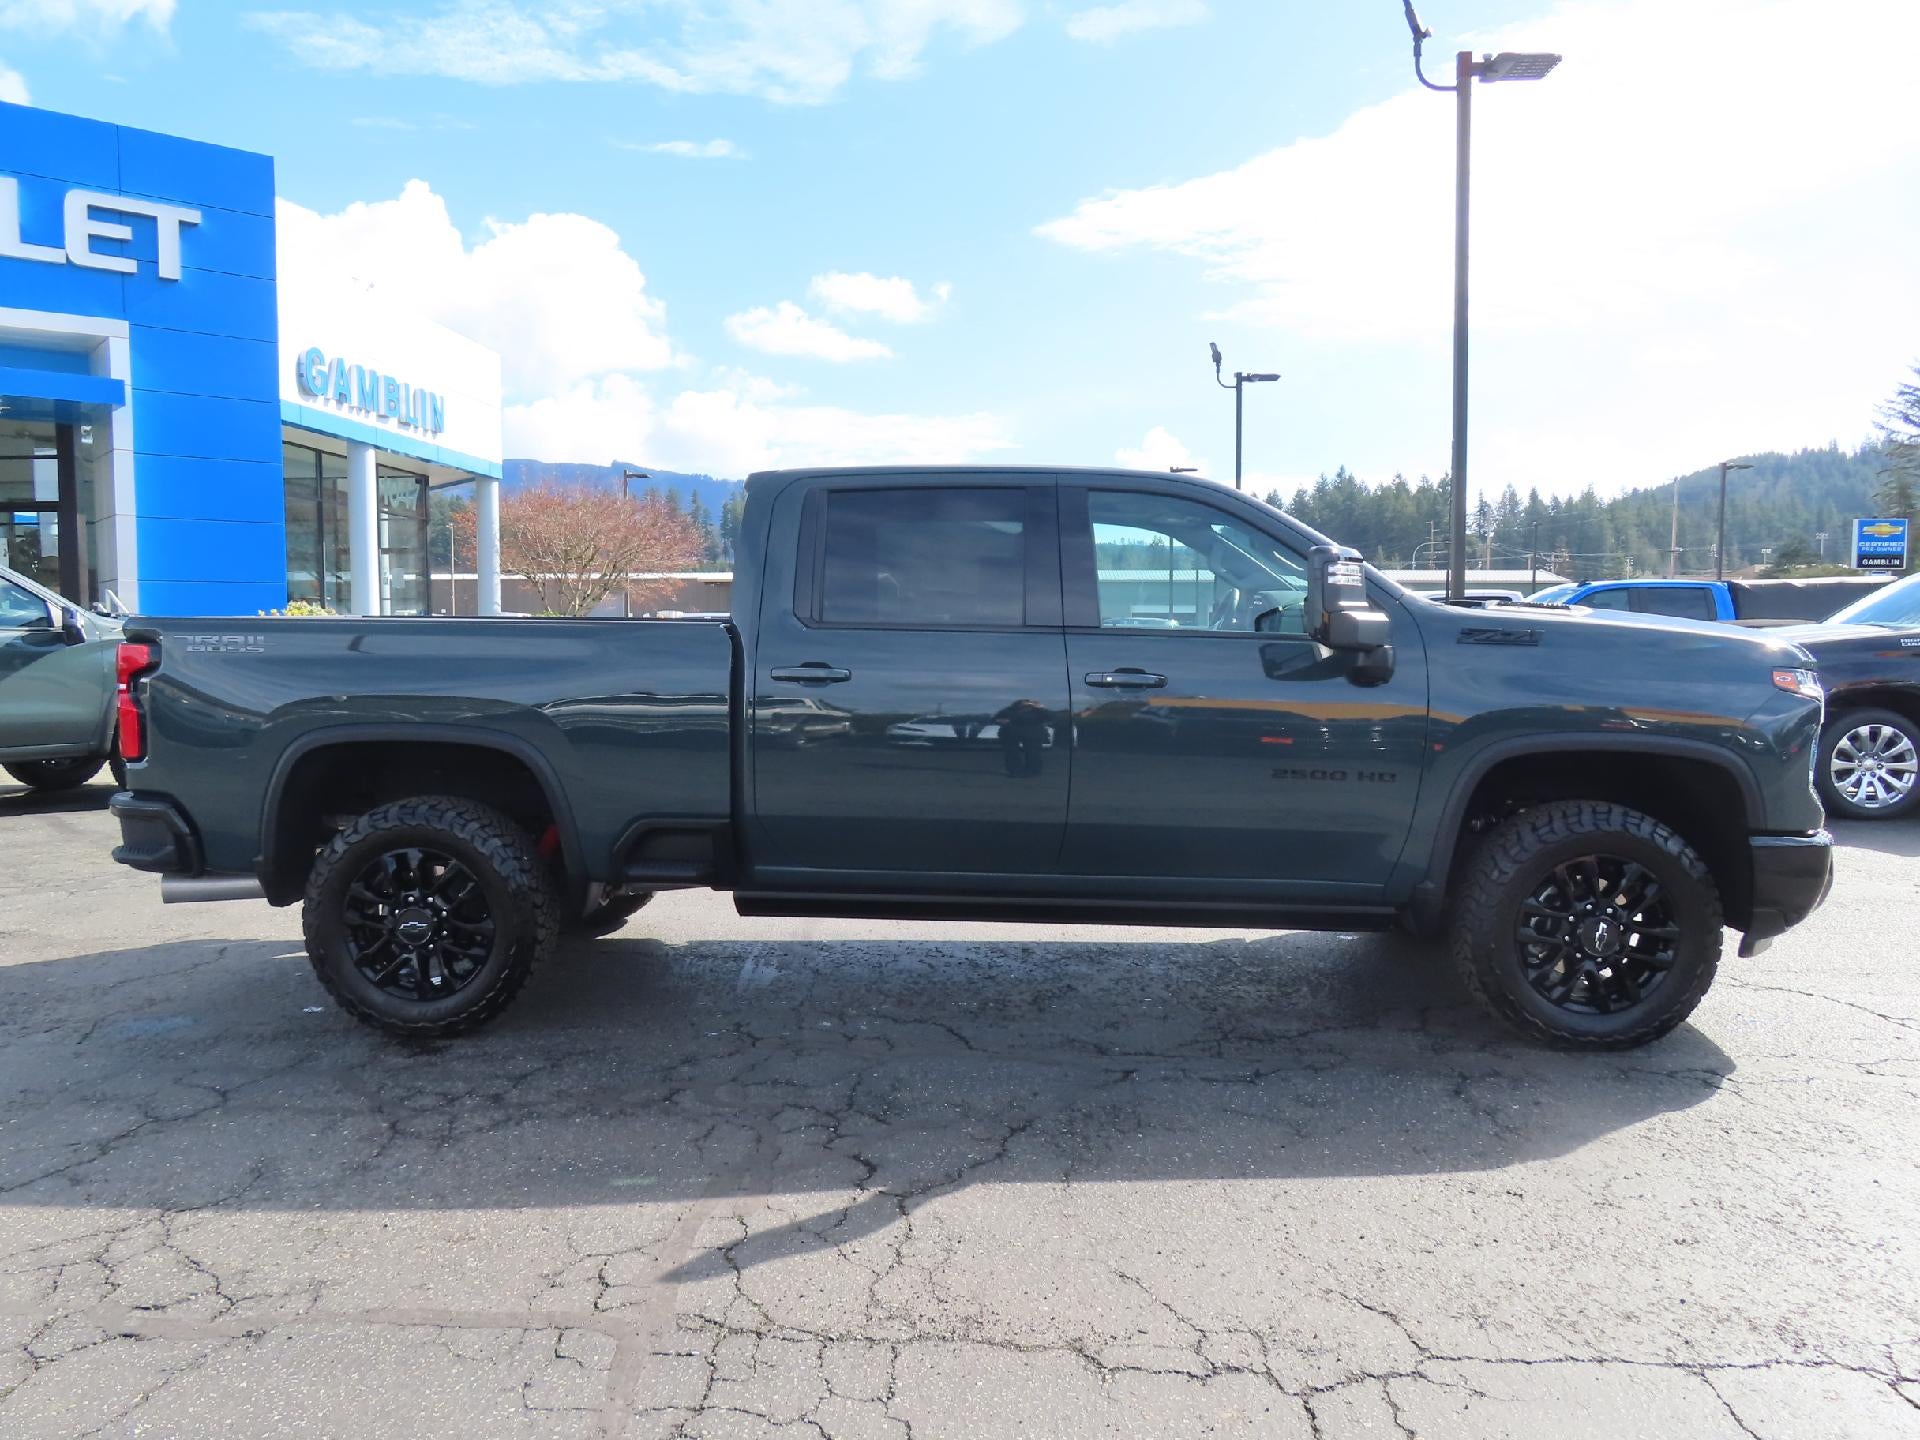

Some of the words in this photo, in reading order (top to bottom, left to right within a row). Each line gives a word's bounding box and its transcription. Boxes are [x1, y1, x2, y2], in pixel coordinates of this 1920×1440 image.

[0, 176, 202, 280] LET
[296, 347, 445, 434] GAMBLIN
[1271, 768, 1348, 782] 2500
[1357, 770, 1398, 783] HD
